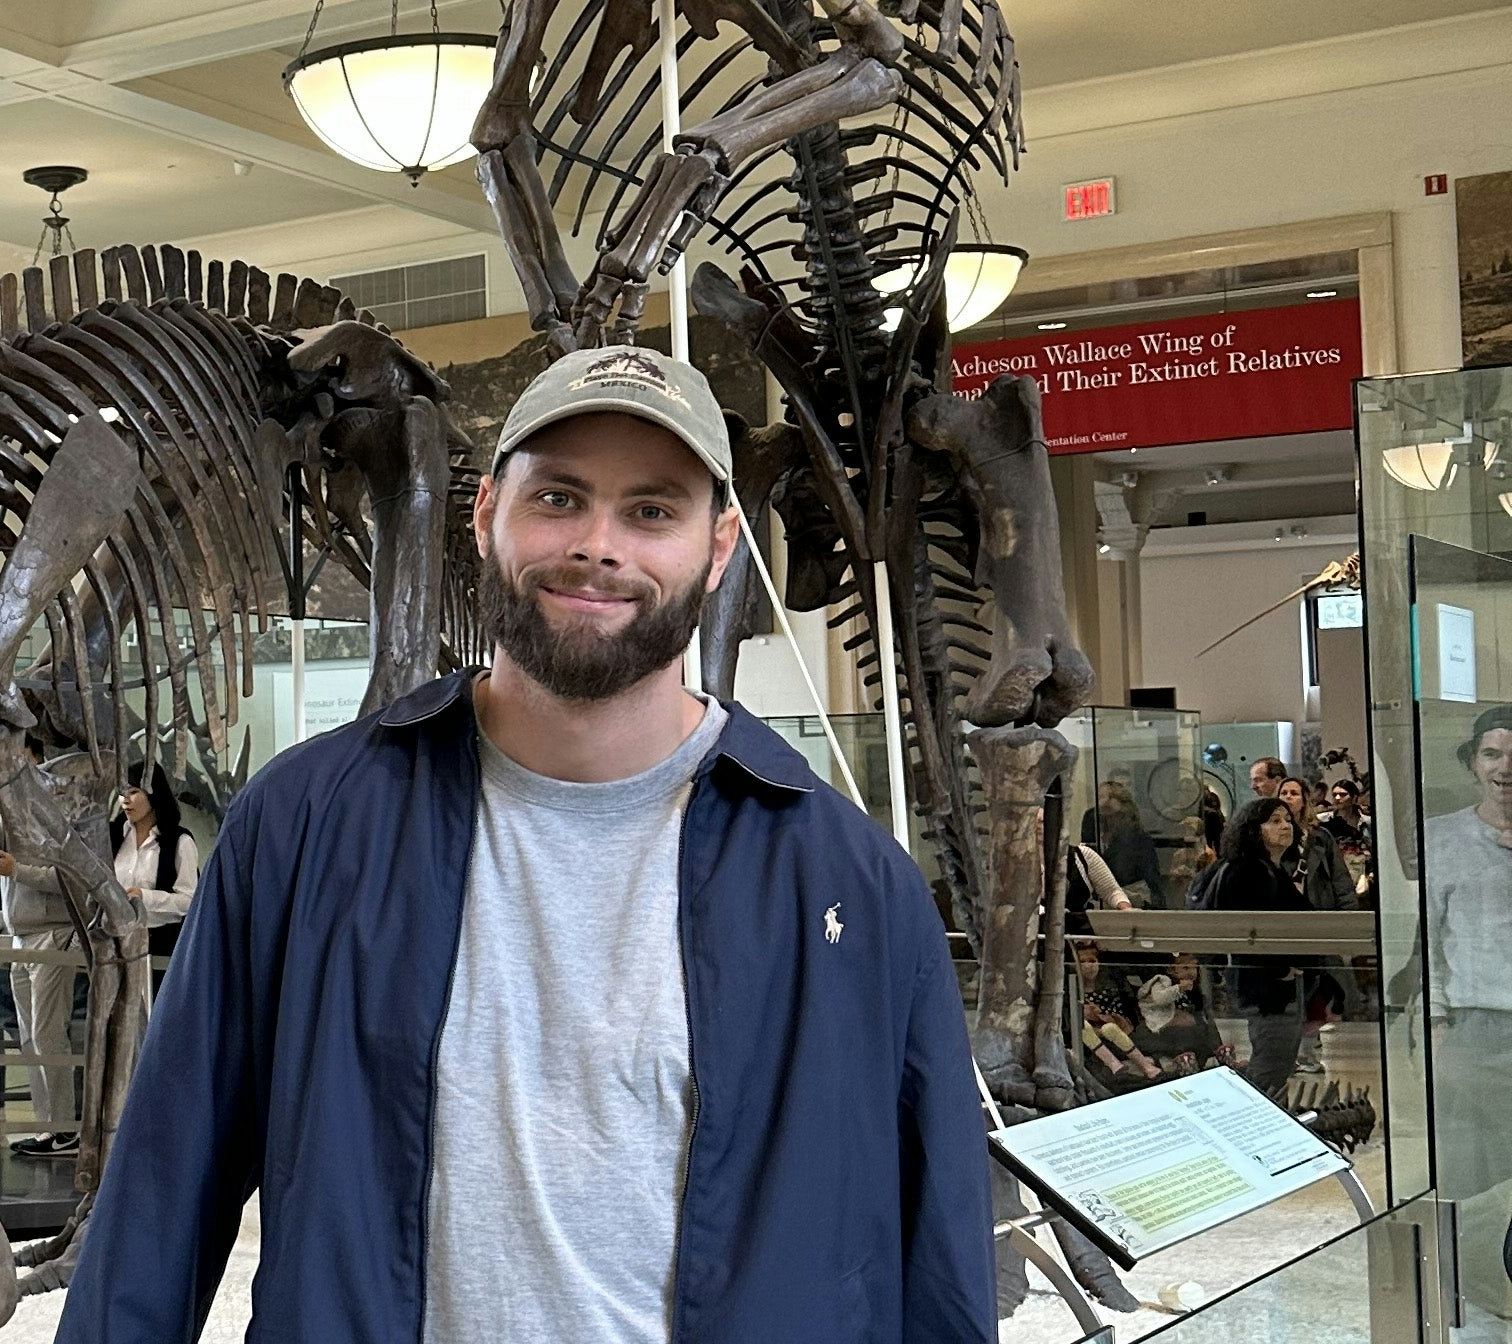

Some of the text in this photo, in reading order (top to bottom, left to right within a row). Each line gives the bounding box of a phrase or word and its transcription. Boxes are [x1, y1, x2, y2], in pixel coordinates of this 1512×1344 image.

[950, 324, 1237, 378] Acheson Wallace Wing of
[1056, 366, 1122, 393] Their
[1128, 357, 1220, 385] Extinct
[1226, 345, 1341, 374] Relatives
[1091, 431, 1128, 443] Center
